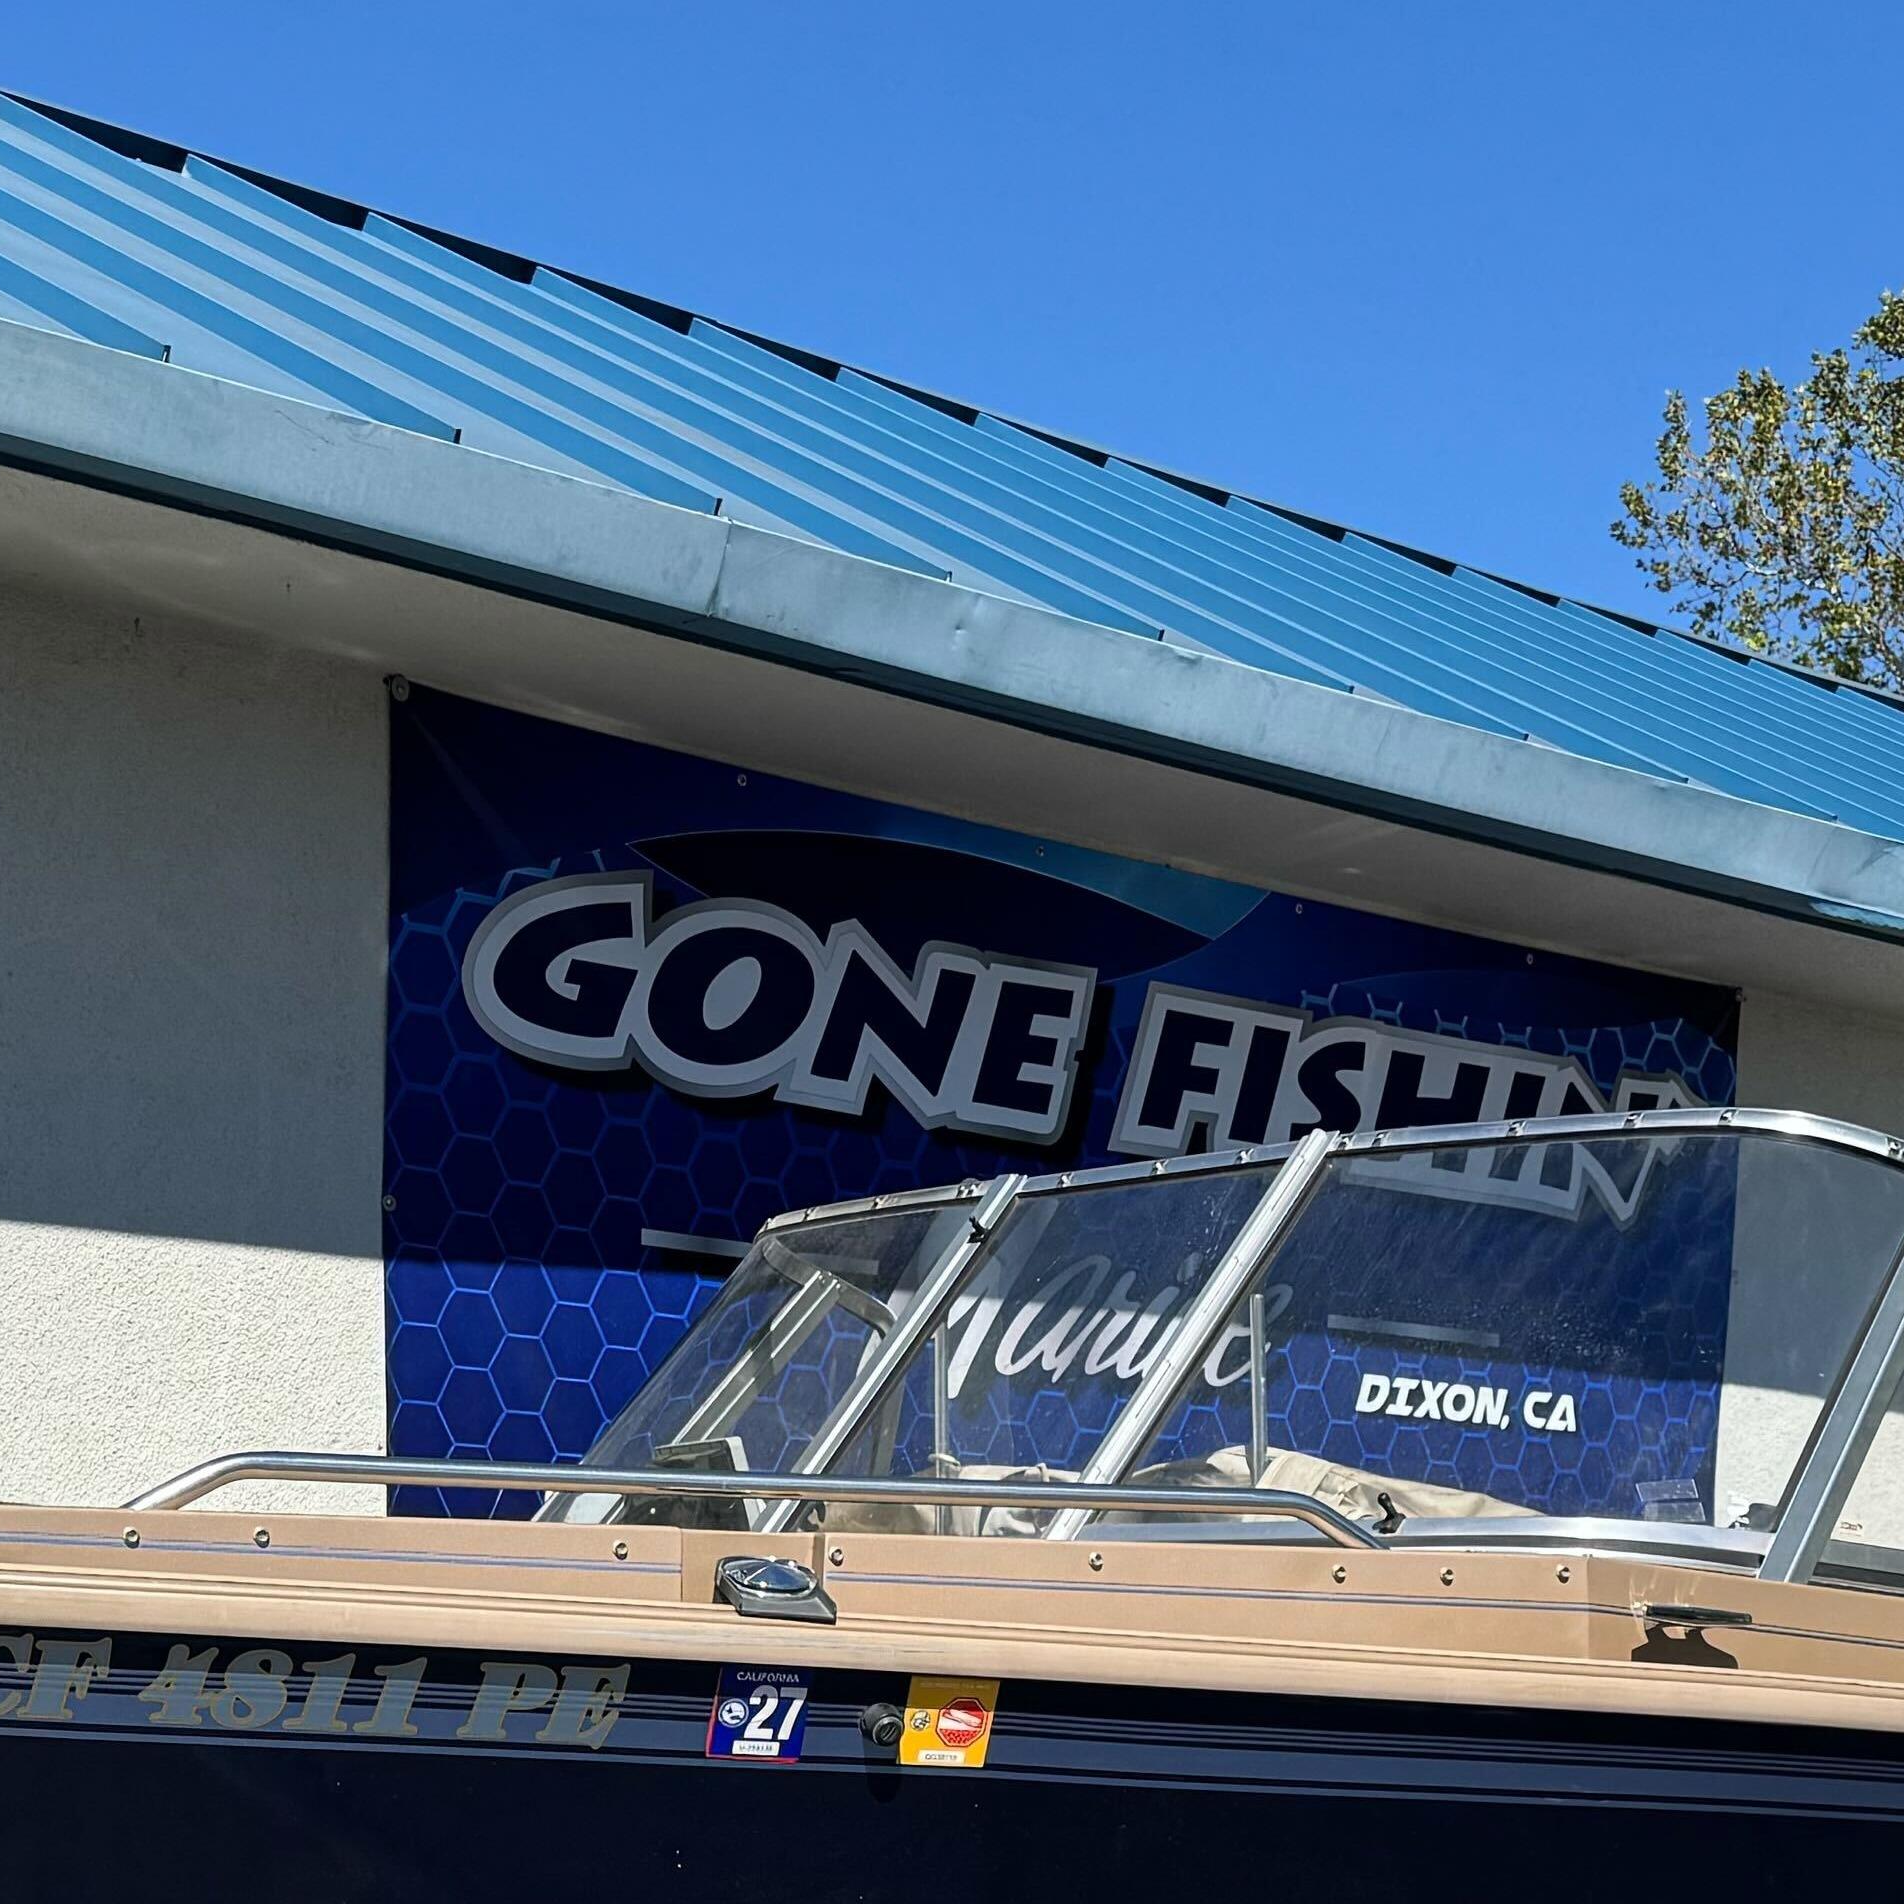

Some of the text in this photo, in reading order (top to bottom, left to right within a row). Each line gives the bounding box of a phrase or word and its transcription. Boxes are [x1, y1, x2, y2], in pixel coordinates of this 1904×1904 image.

[474, 883, 1698, 1220] GONE FISHIN
[855, 1197, 1294, 1400] Marie
[1355, 1373, 1577, 1432] DIXON, CA
[138, 1643, 427, 1735] 4811
[456, 1661, 630, 1750] PE
[744, 1685, 808, 1740] 27
